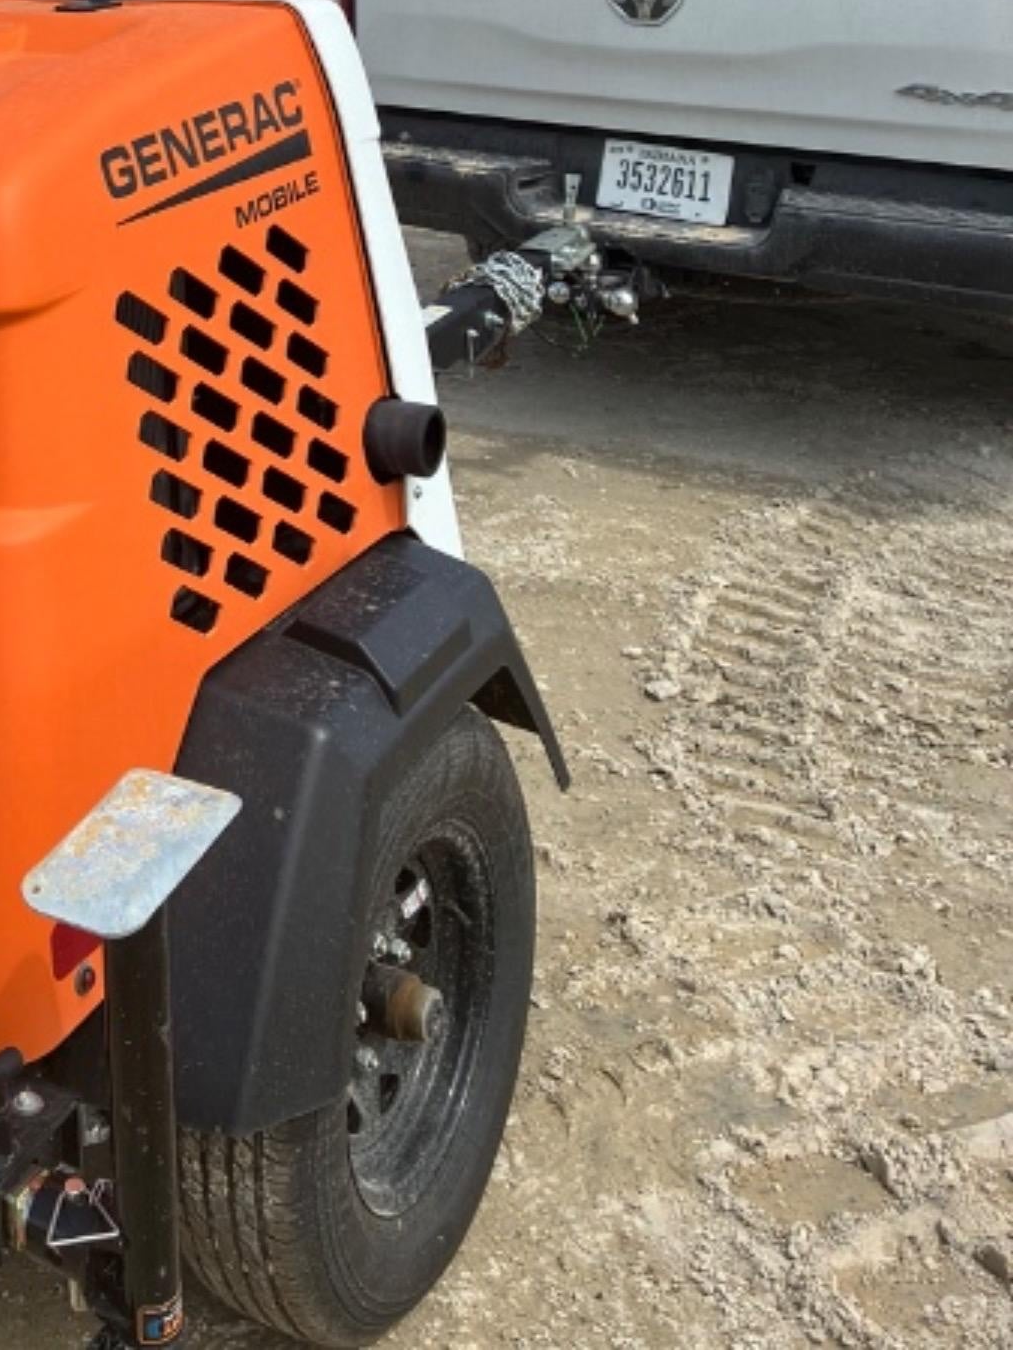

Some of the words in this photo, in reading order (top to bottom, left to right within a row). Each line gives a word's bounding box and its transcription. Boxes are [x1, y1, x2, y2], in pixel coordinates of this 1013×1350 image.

[99, 80, 304, 199] GENERAC
[235, 170, 321, 229] MOBILE
[616, 158, 712, 202] 3532611
